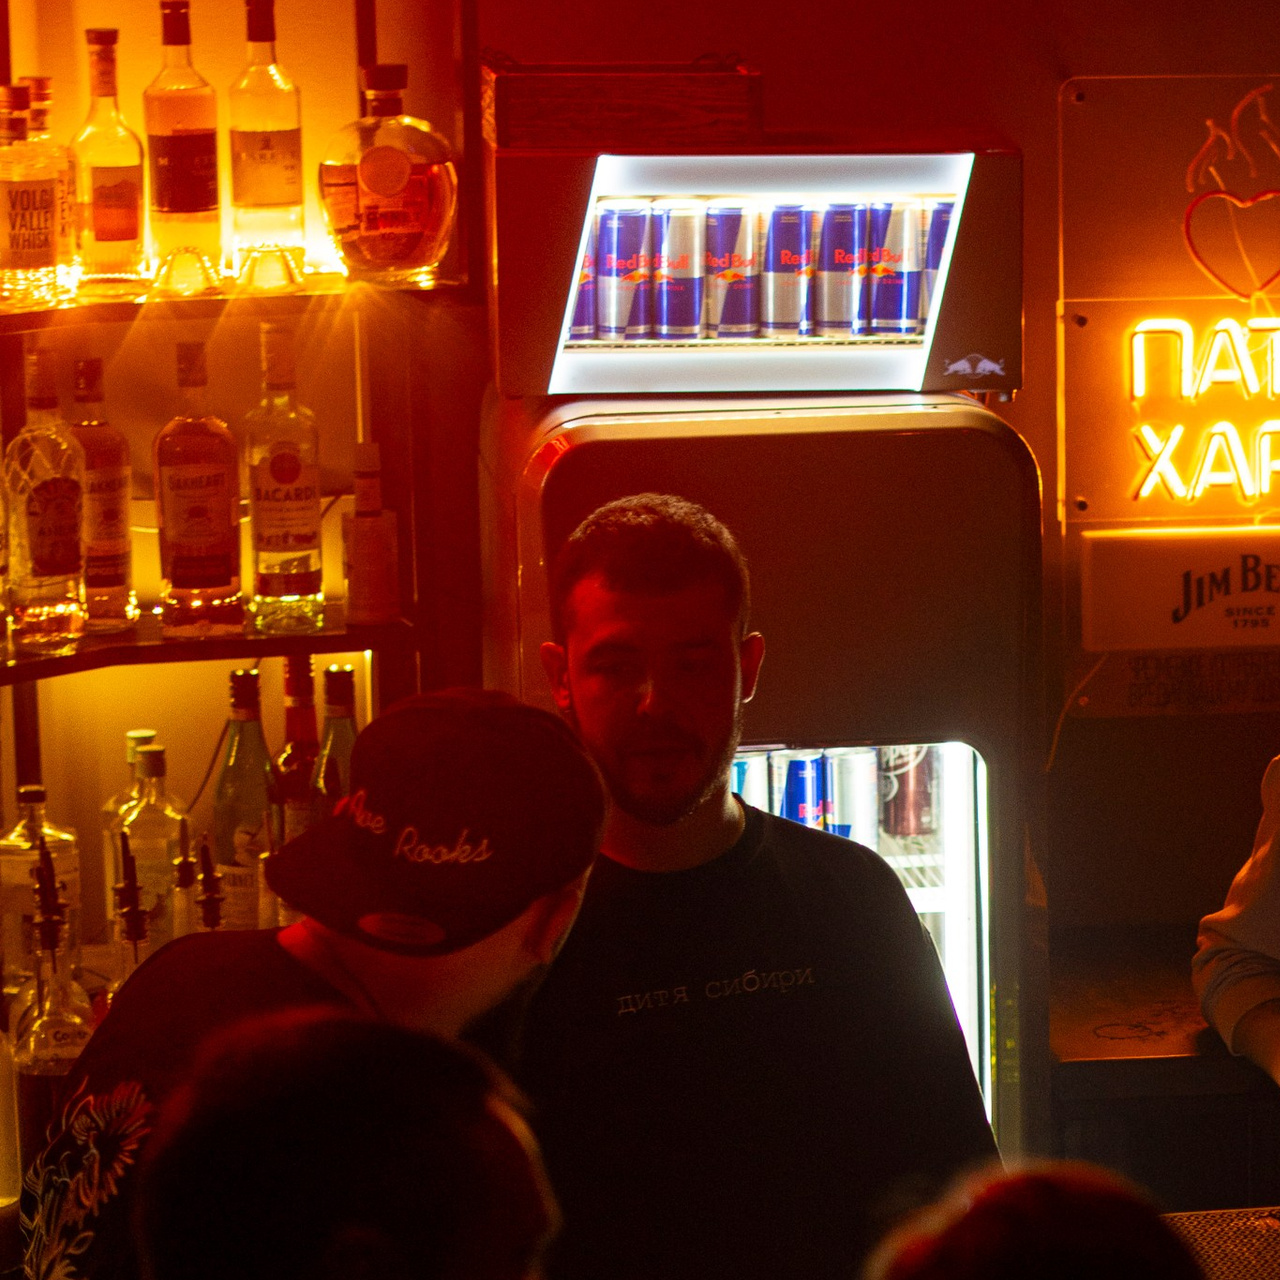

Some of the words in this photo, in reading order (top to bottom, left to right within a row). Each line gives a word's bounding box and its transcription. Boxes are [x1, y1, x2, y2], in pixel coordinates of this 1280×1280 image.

[1171, 567, 1232, 625] JIM
[1225, 606, 1276, 618] SINCE
[395, 825, 495, 864] Rooks
[616, 985, 690, 1017] дитя
[705, 967, 816, 999] сибири
